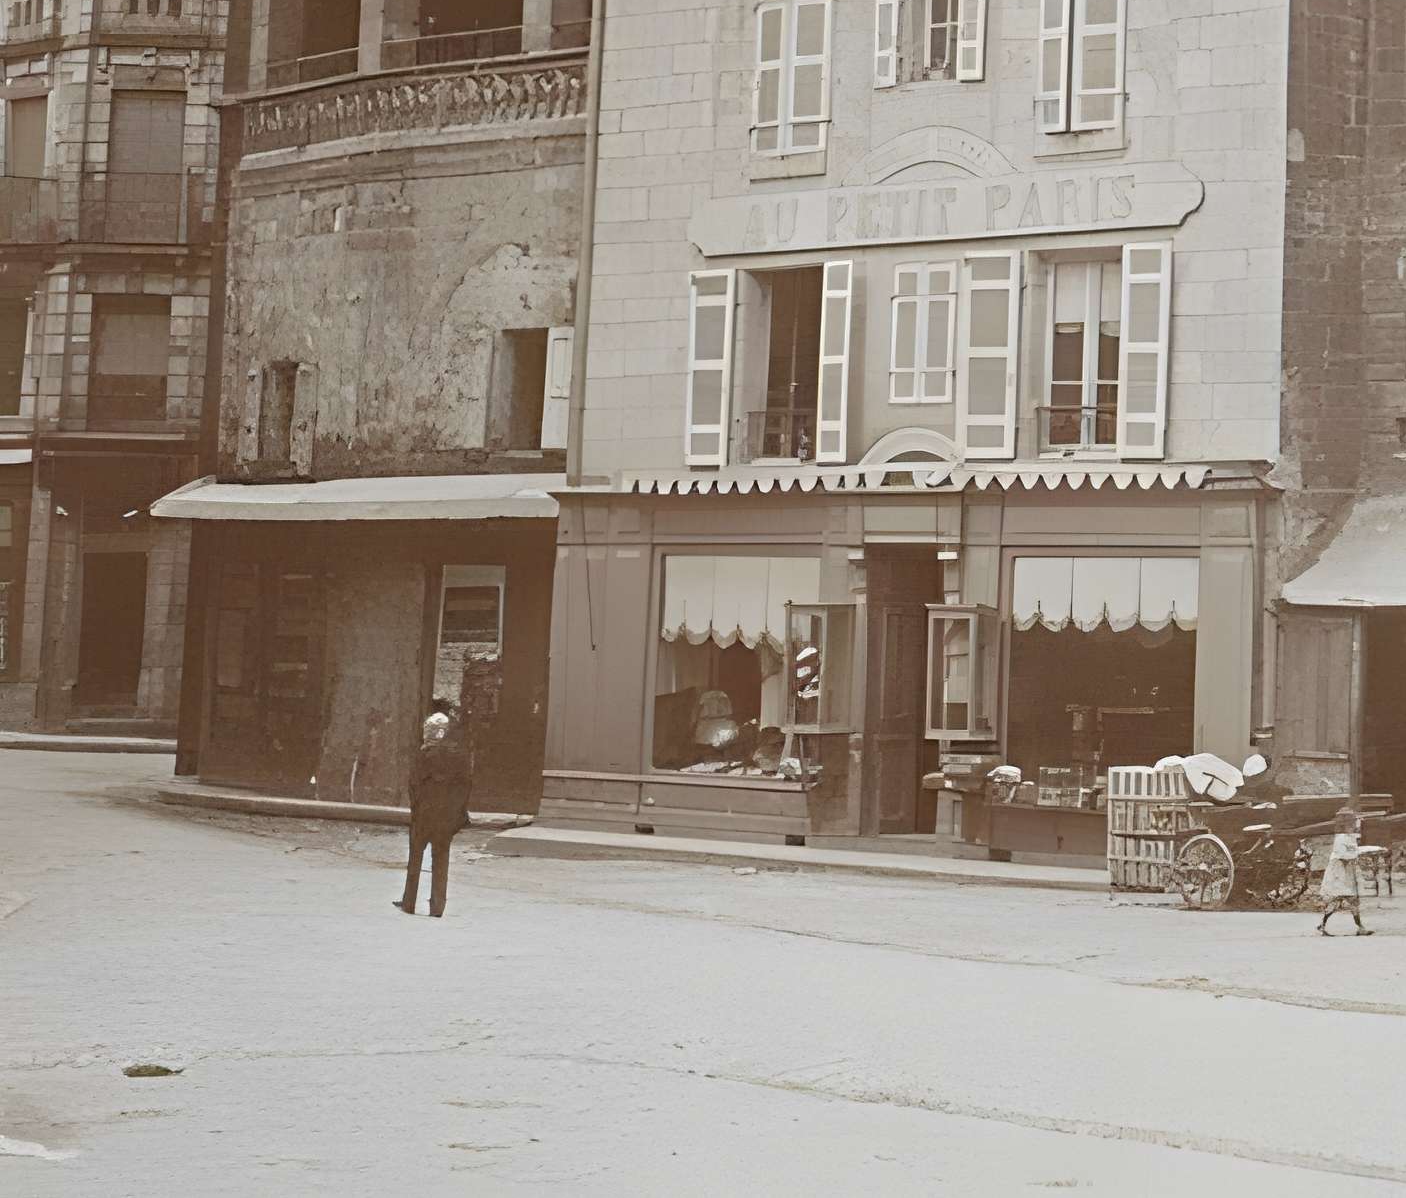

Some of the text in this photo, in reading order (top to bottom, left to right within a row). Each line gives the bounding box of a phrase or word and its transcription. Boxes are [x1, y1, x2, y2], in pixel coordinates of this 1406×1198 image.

[743, 174, 1135, 248] AU PETIT PARIS
